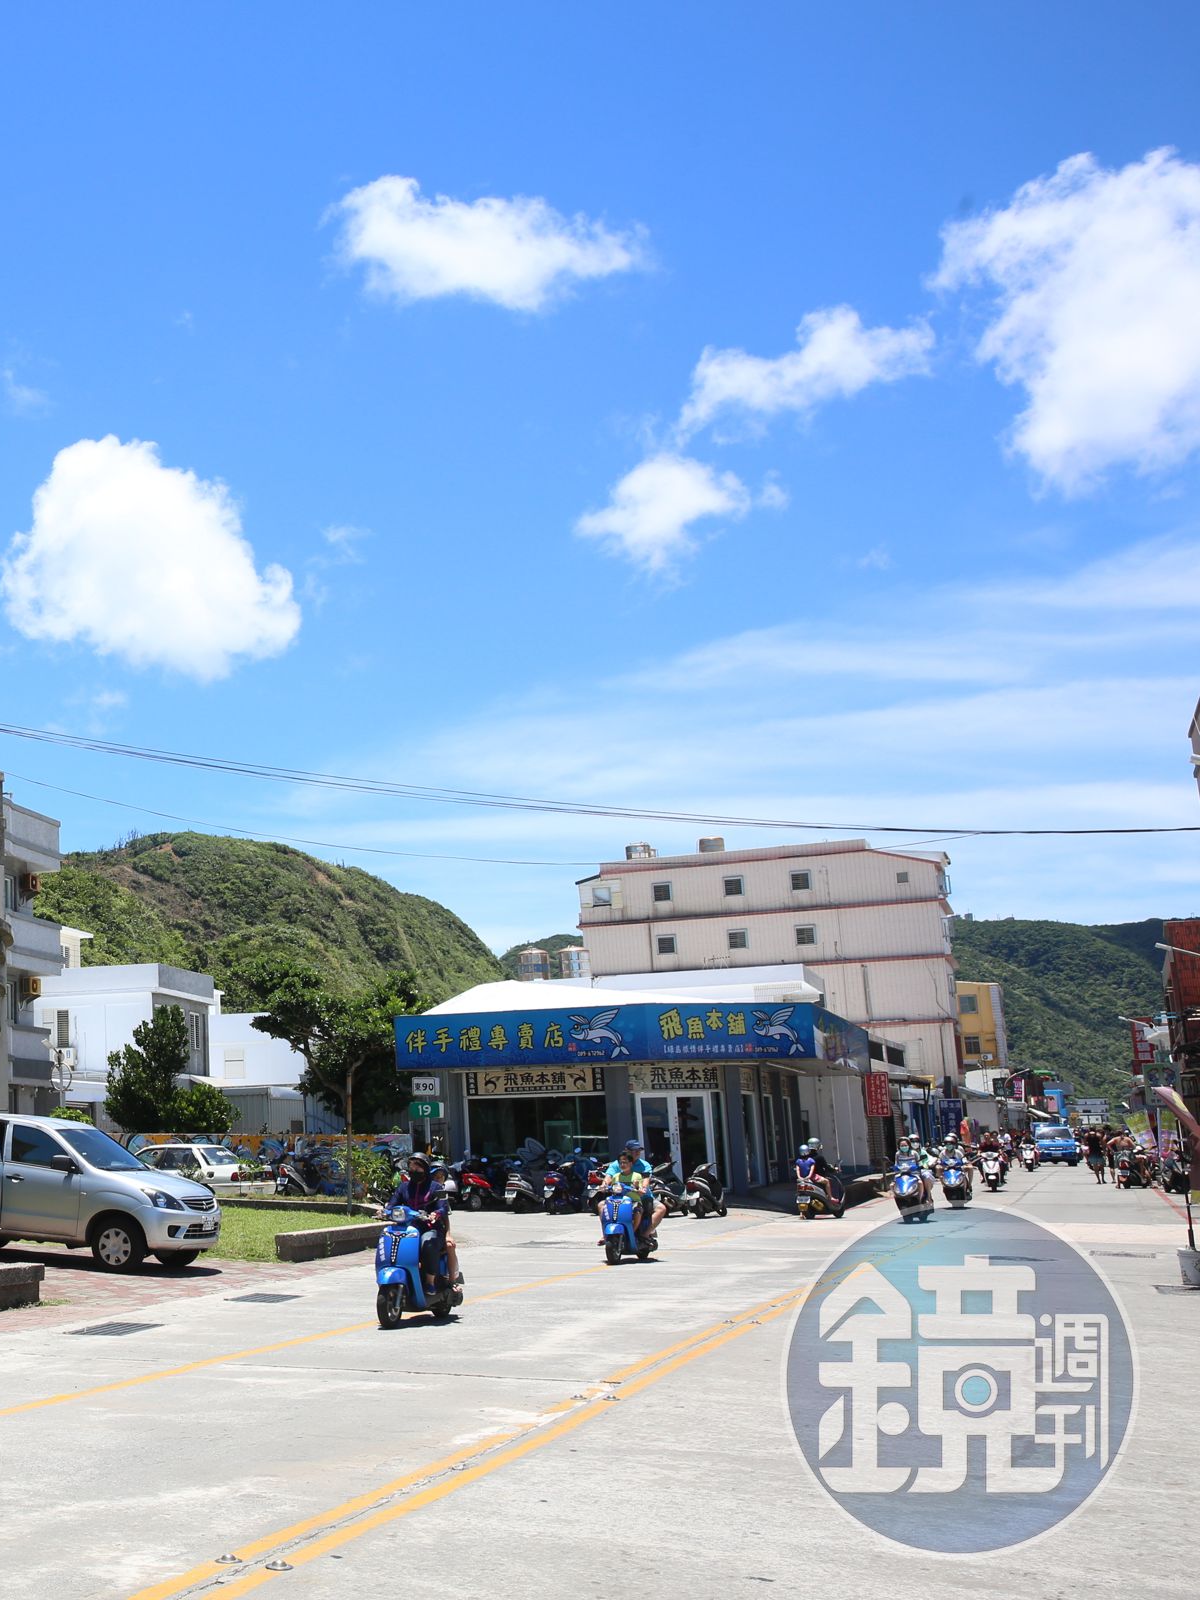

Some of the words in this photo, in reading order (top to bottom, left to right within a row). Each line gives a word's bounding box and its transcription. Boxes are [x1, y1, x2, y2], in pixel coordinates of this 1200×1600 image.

[406, 1023, 564, 1053] 伴手禮專賣店
[418, 1105, 431, 1116] 19
